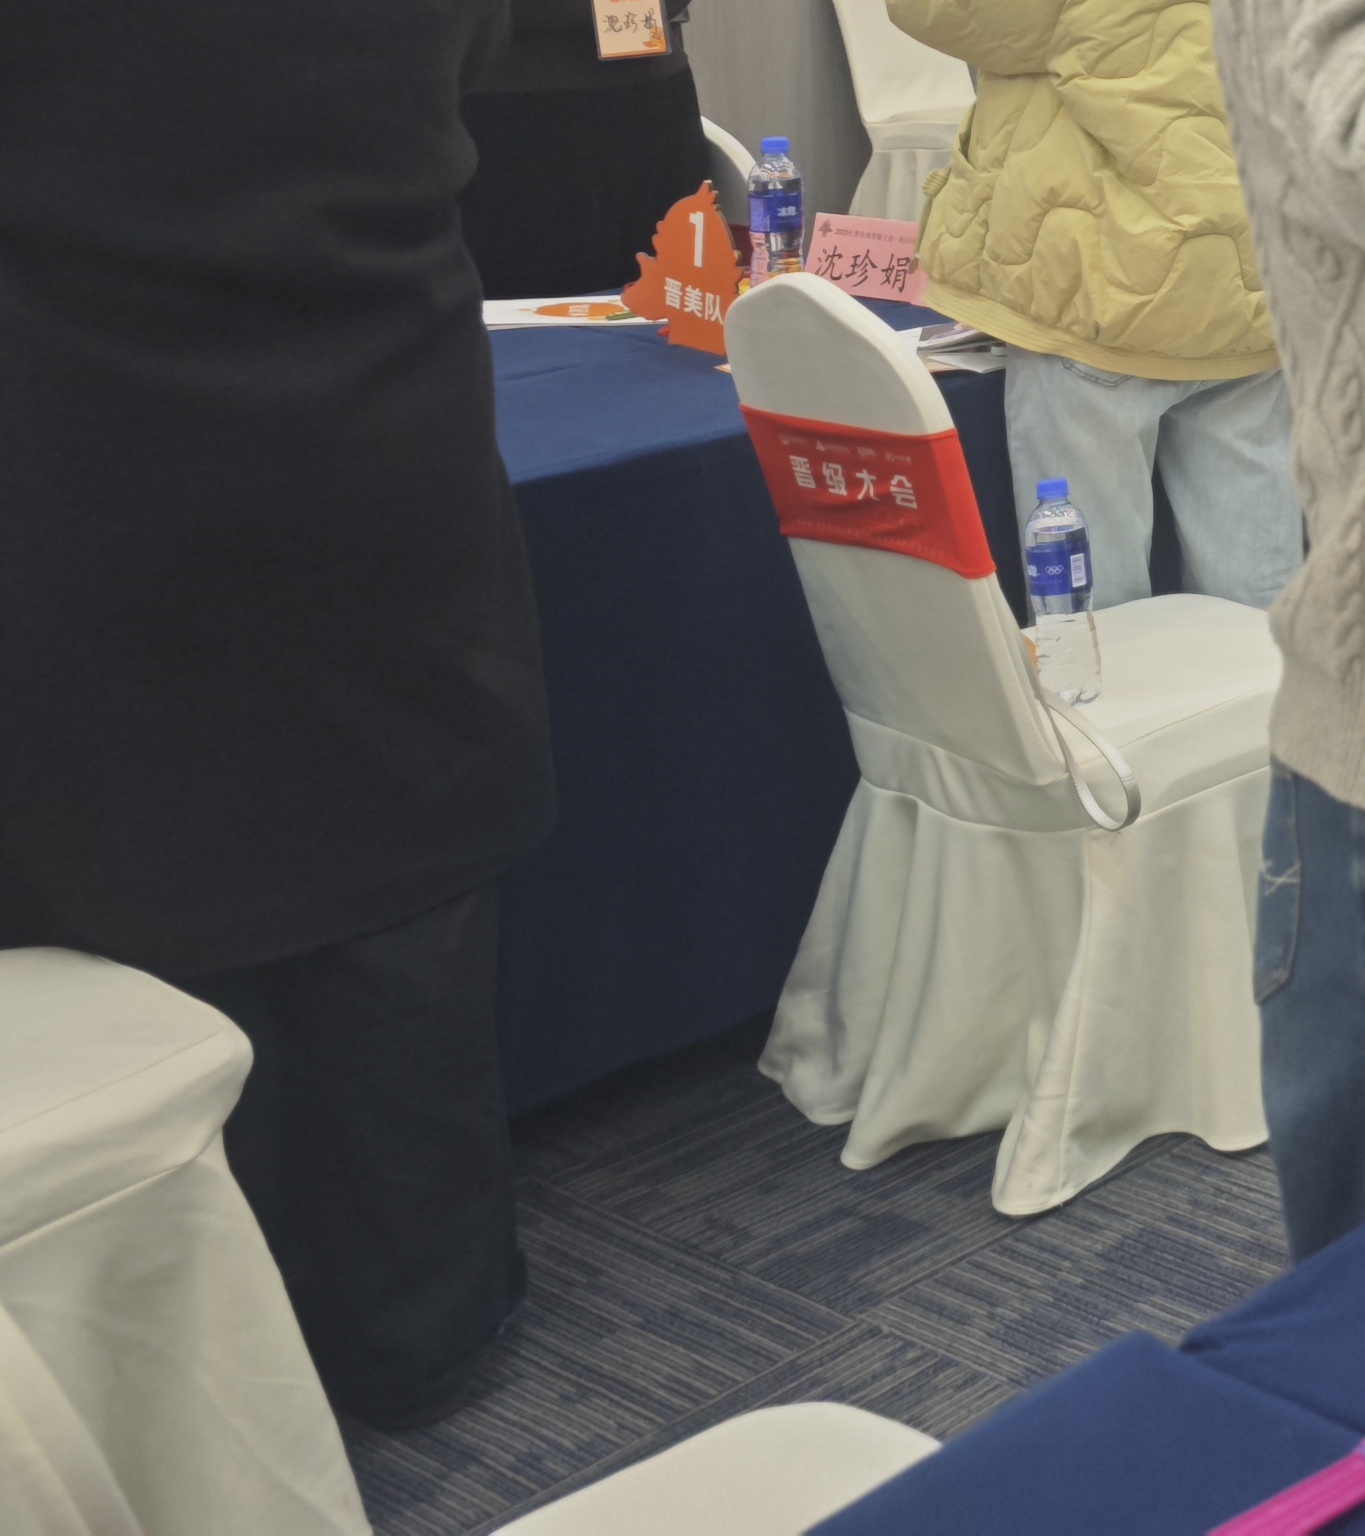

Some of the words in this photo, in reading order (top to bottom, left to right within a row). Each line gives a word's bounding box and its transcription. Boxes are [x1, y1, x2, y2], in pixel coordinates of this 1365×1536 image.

[689, 210, 704, 268] 1
[815, 245, 911, 293] 沈珍娟
[664, 277, 723, 325] 晋美队
[789, 454, 918, 509] 晋级大会
